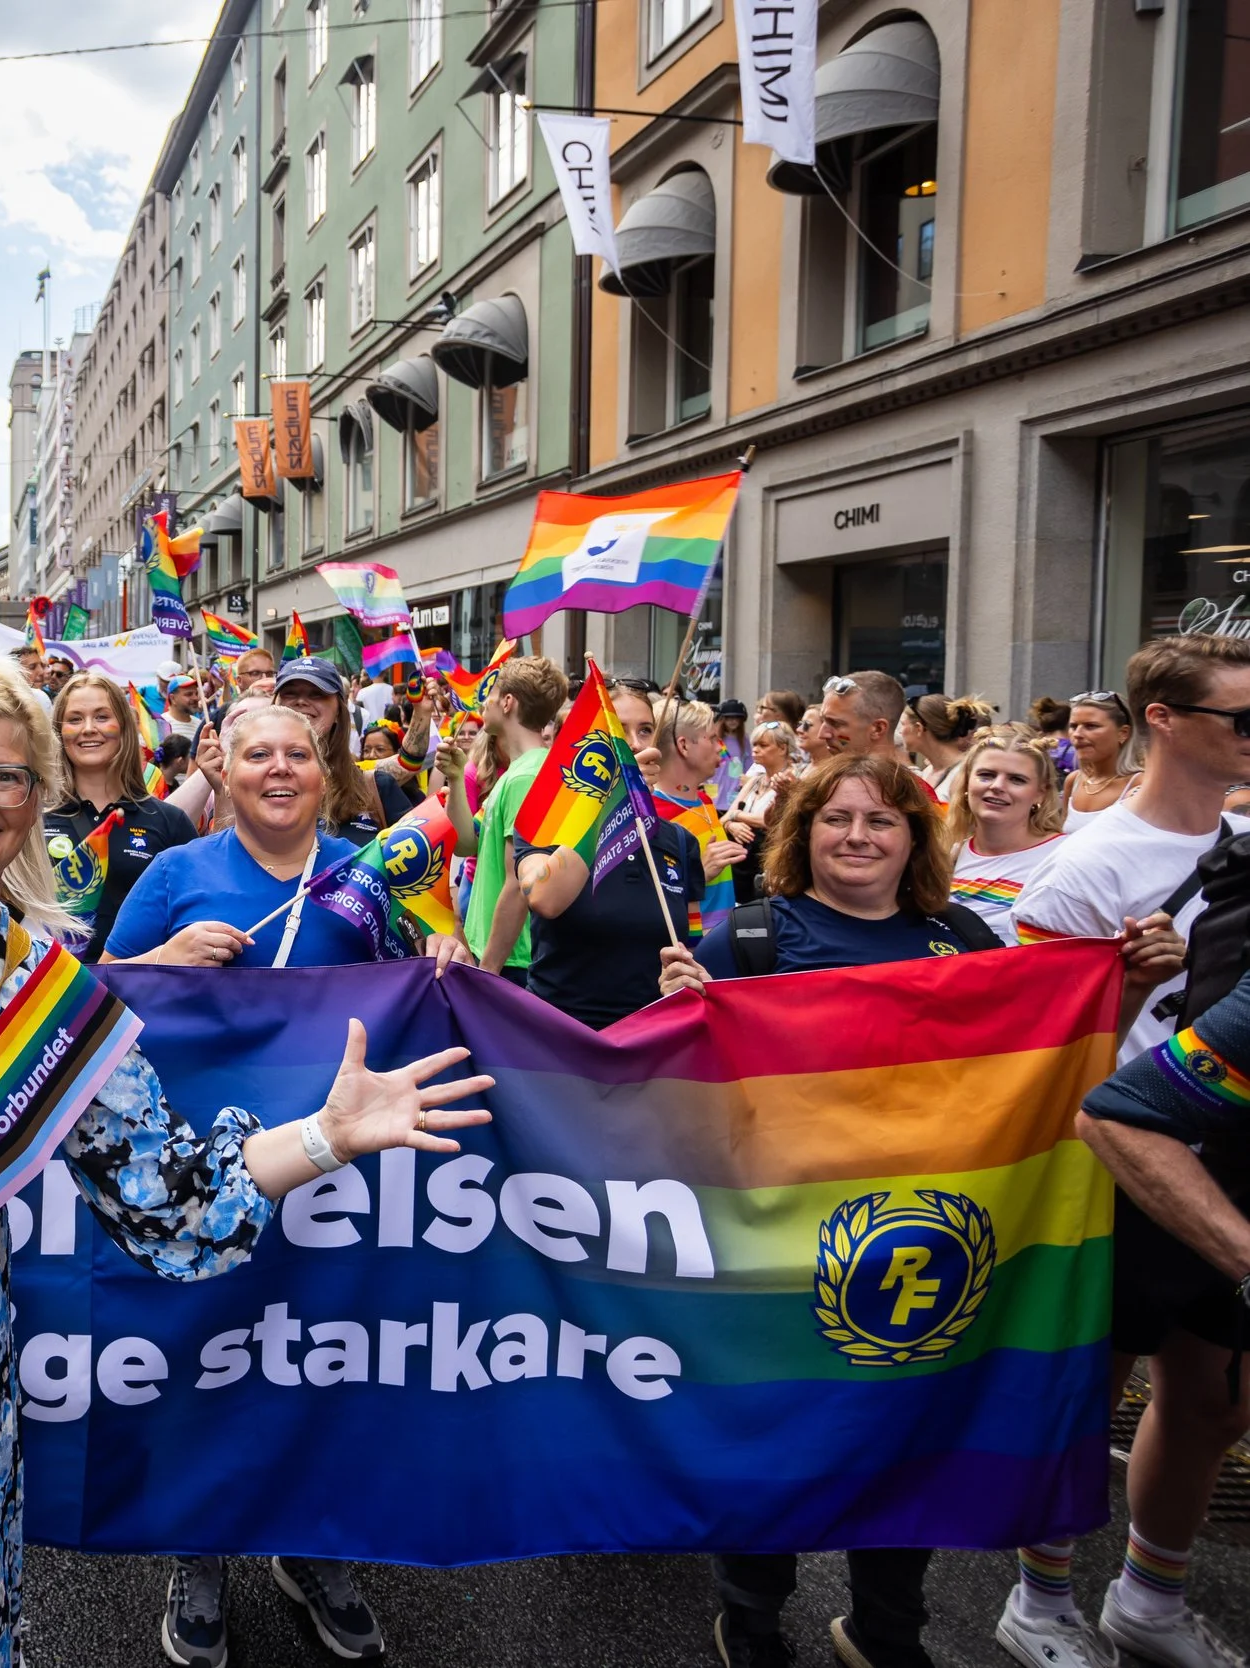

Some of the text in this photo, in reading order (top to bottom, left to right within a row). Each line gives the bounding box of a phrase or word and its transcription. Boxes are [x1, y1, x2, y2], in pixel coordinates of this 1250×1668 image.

[752, 0, 794, 122] HIMI
[248, 425, 267, 490] stadium
[286, 390, 303, 470] stadium
[834, 503, 880, 530] CHIMI
[195, 1300, 681, 1400] starkare
